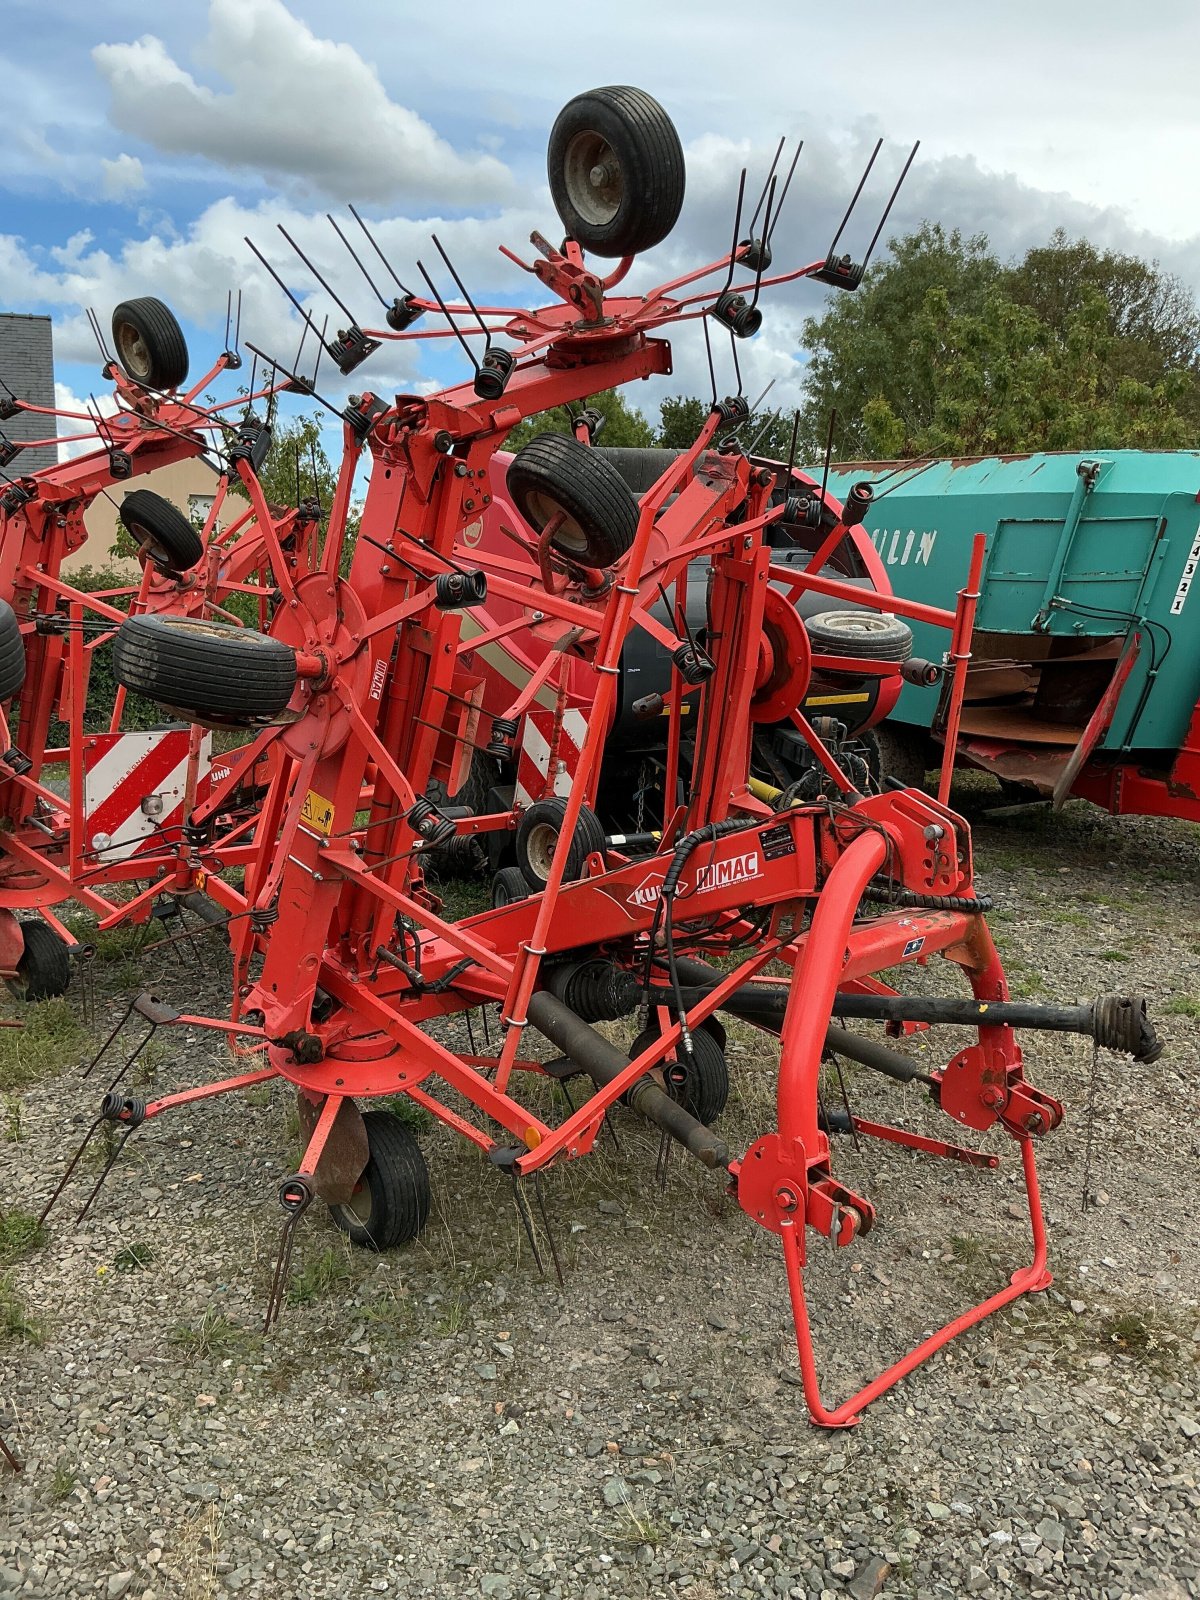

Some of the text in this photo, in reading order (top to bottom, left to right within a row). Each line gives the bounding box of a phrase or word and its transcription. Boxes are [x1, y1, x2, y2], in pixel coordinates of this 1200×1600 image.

[1185, 563, 1193, 574] 3
[1180, 582, 1188, 592] 2
[1174, 600, 1182, 610] 1
[211, 768, 231, 783] UHN
[697, 853, 757, 890] HIMAC
[634, 883, 680, 905] KU
